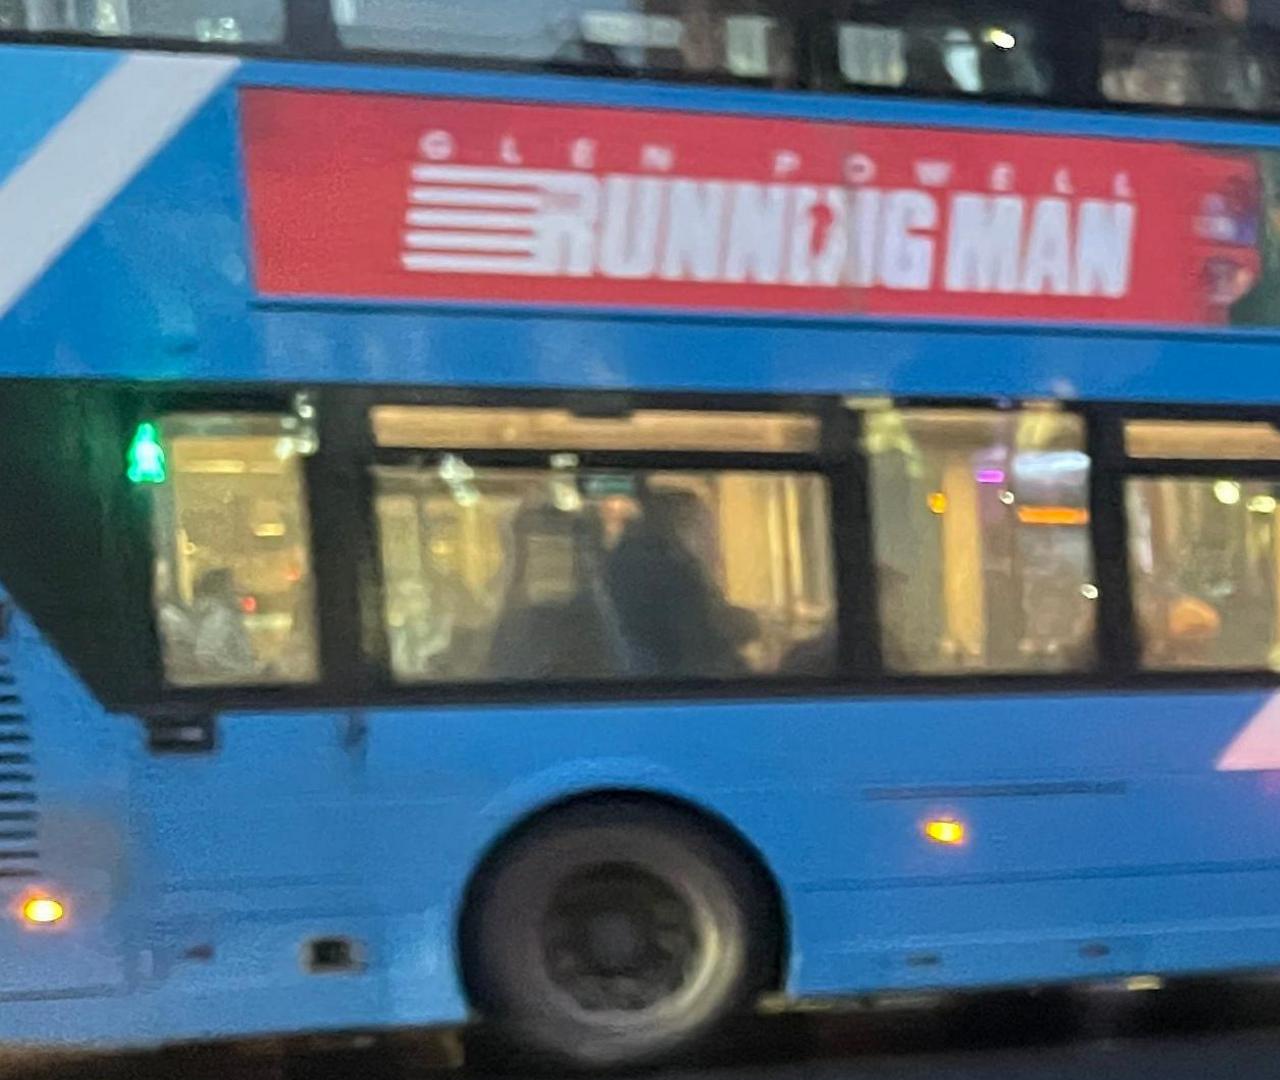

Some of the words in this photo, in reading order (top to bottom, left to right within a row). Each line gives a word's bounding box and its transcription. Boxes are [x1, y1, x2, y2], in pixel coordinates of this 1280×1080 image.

[418, 129, 674, 172] GLEN
[772, 149, 1132, 198] POWELL
[402, 163, 939, 290] RUNNING
[944, 191, 1136, 298] MAN
